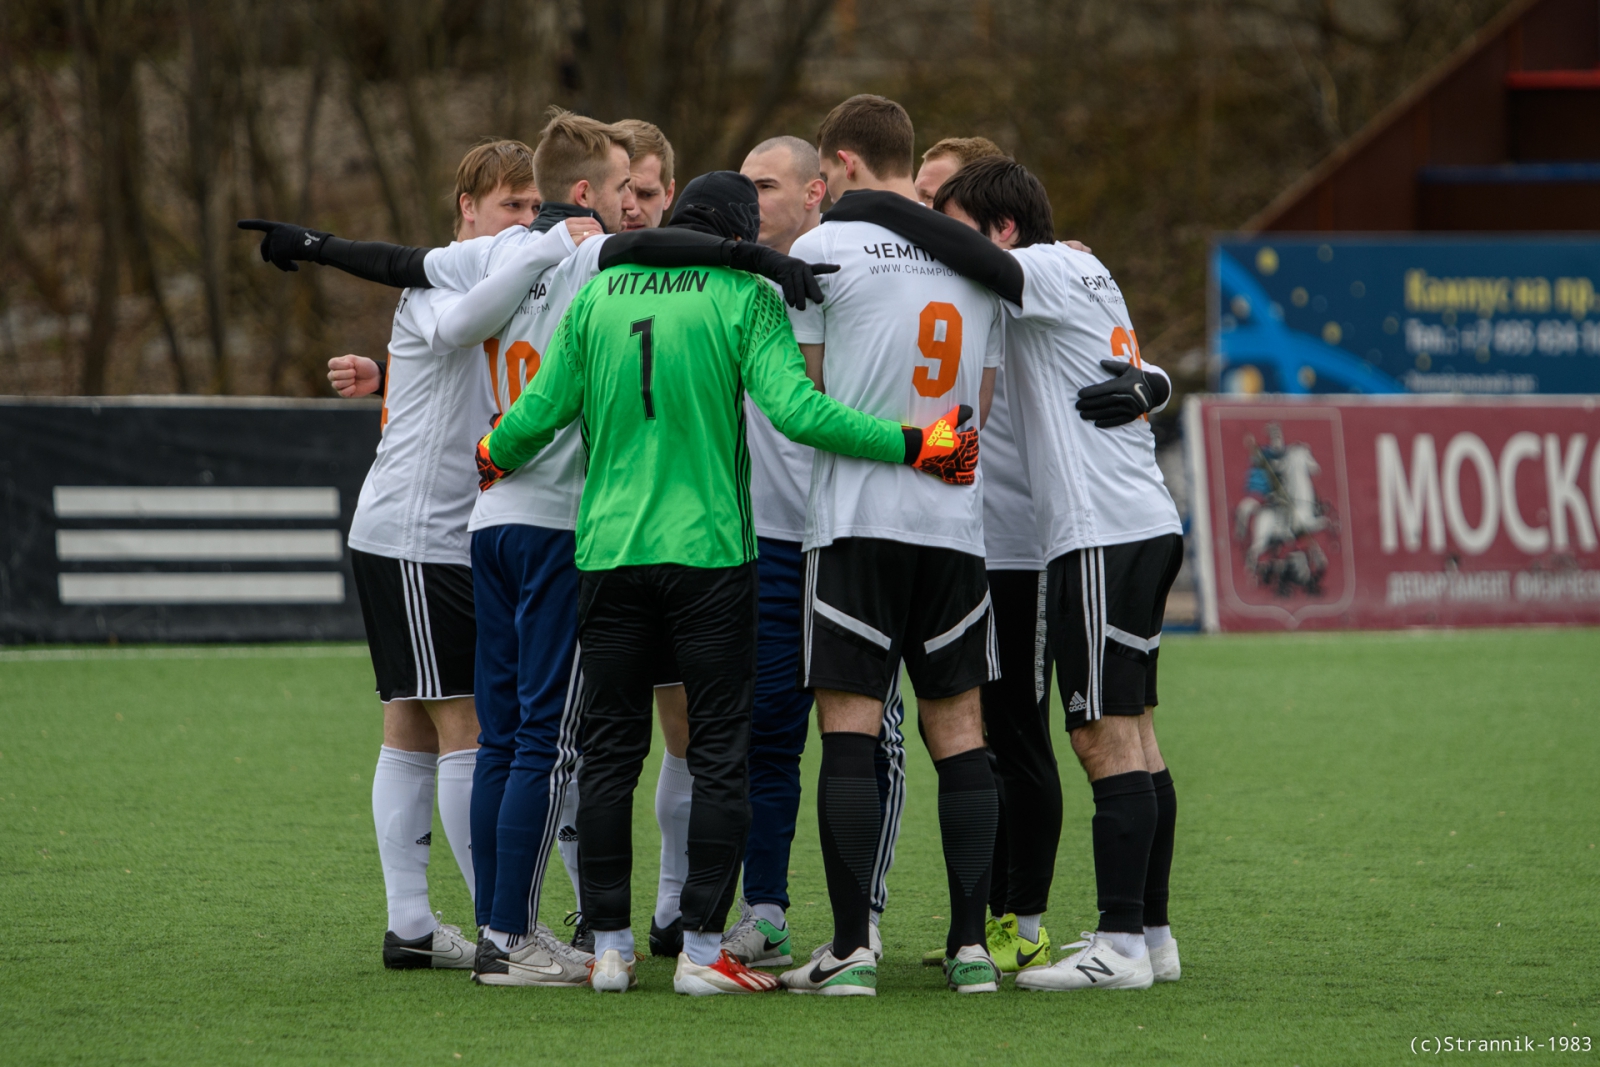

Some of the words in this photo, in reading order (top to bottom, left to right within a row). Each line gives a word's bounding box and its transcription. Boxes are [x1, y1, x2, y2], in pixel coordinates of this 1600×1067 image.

[608, 270, 710, 296] VITAMIN
[630, 315, 656, 420] 1
[912, 301, 963, 398] 9
[1376, 432, 1600, 555] МОСК
